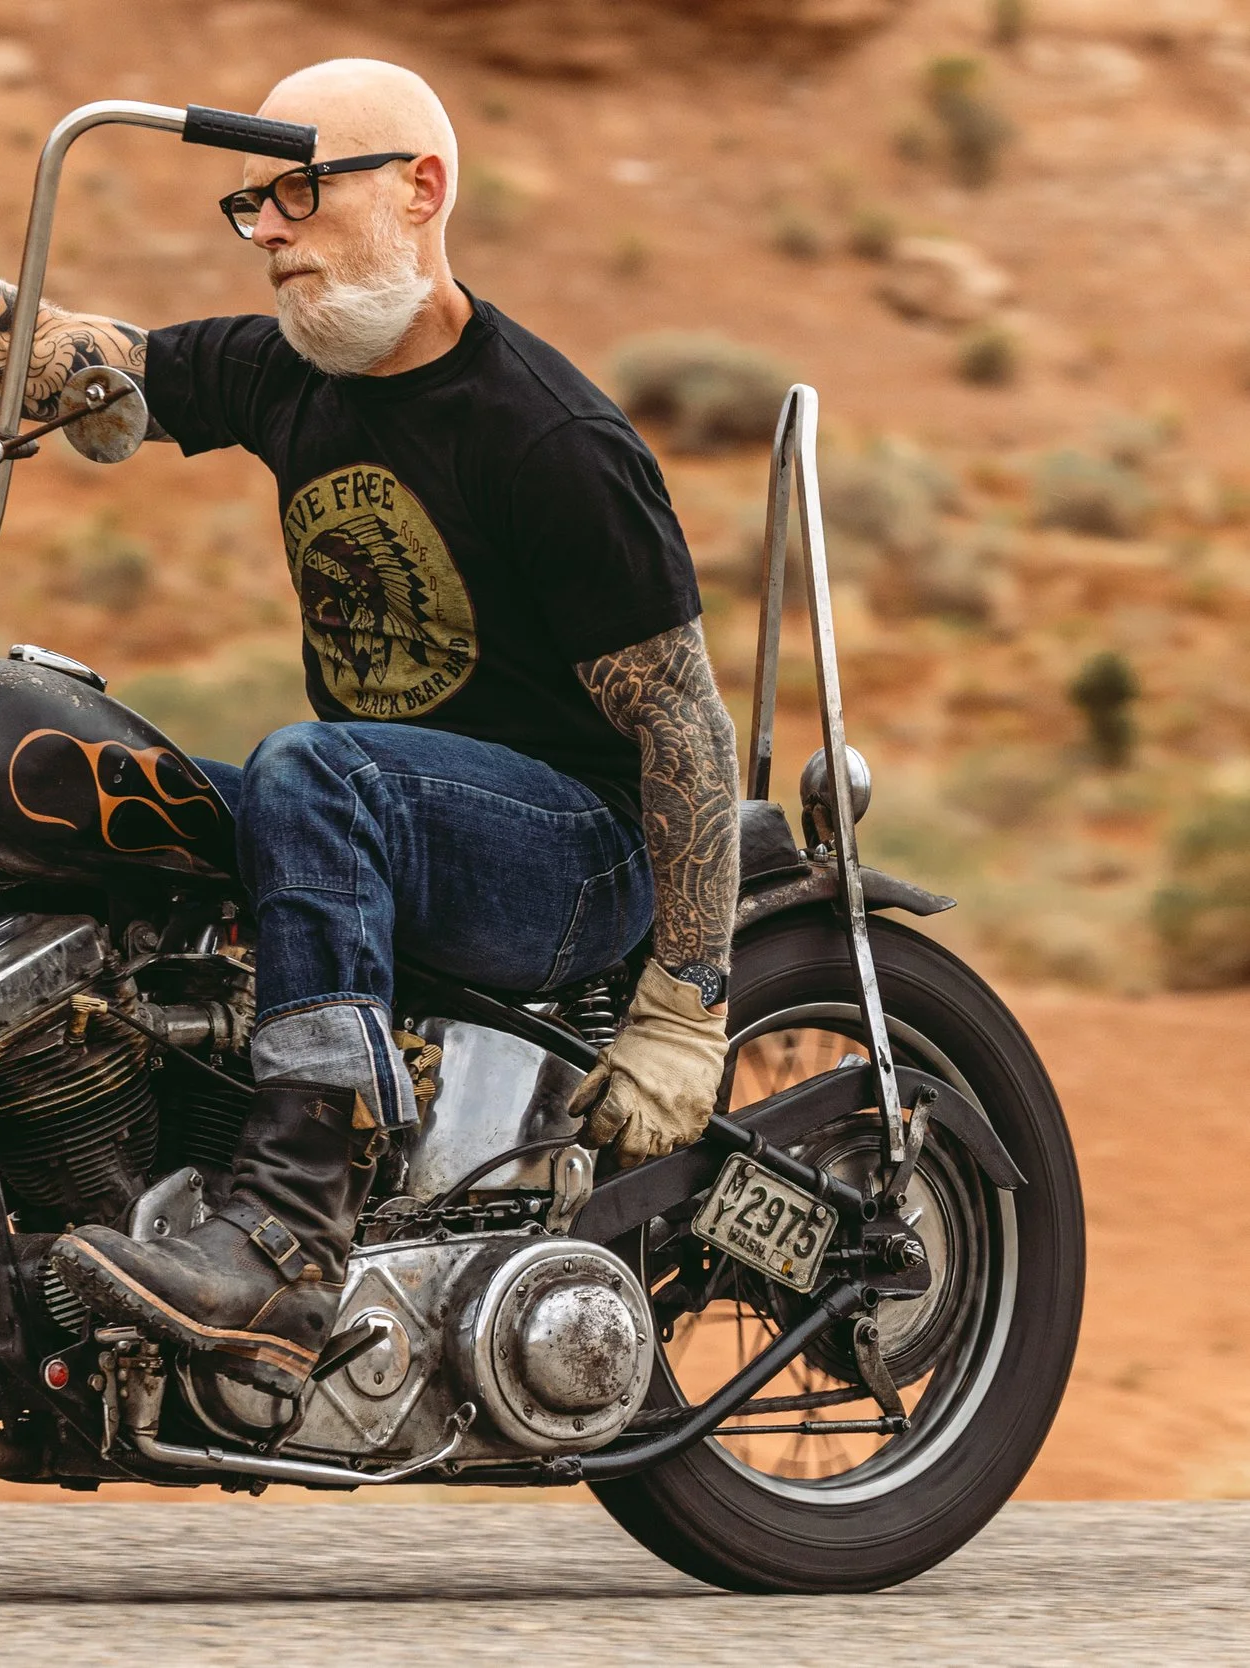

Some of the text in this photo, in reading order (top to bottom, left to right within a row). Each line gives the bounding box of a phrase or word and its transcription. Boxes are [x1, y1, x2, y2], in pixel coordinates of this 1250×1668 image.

[285, 487, 325, 568] LIVE
[399, 520, 428, 562] RIDE
[430, 576, 447, 623] DIE
[355, 690, 402, 715] BLACK
[402, 672, 451, 710] BEAR
[735, 1186, 825, 1259] 2975
